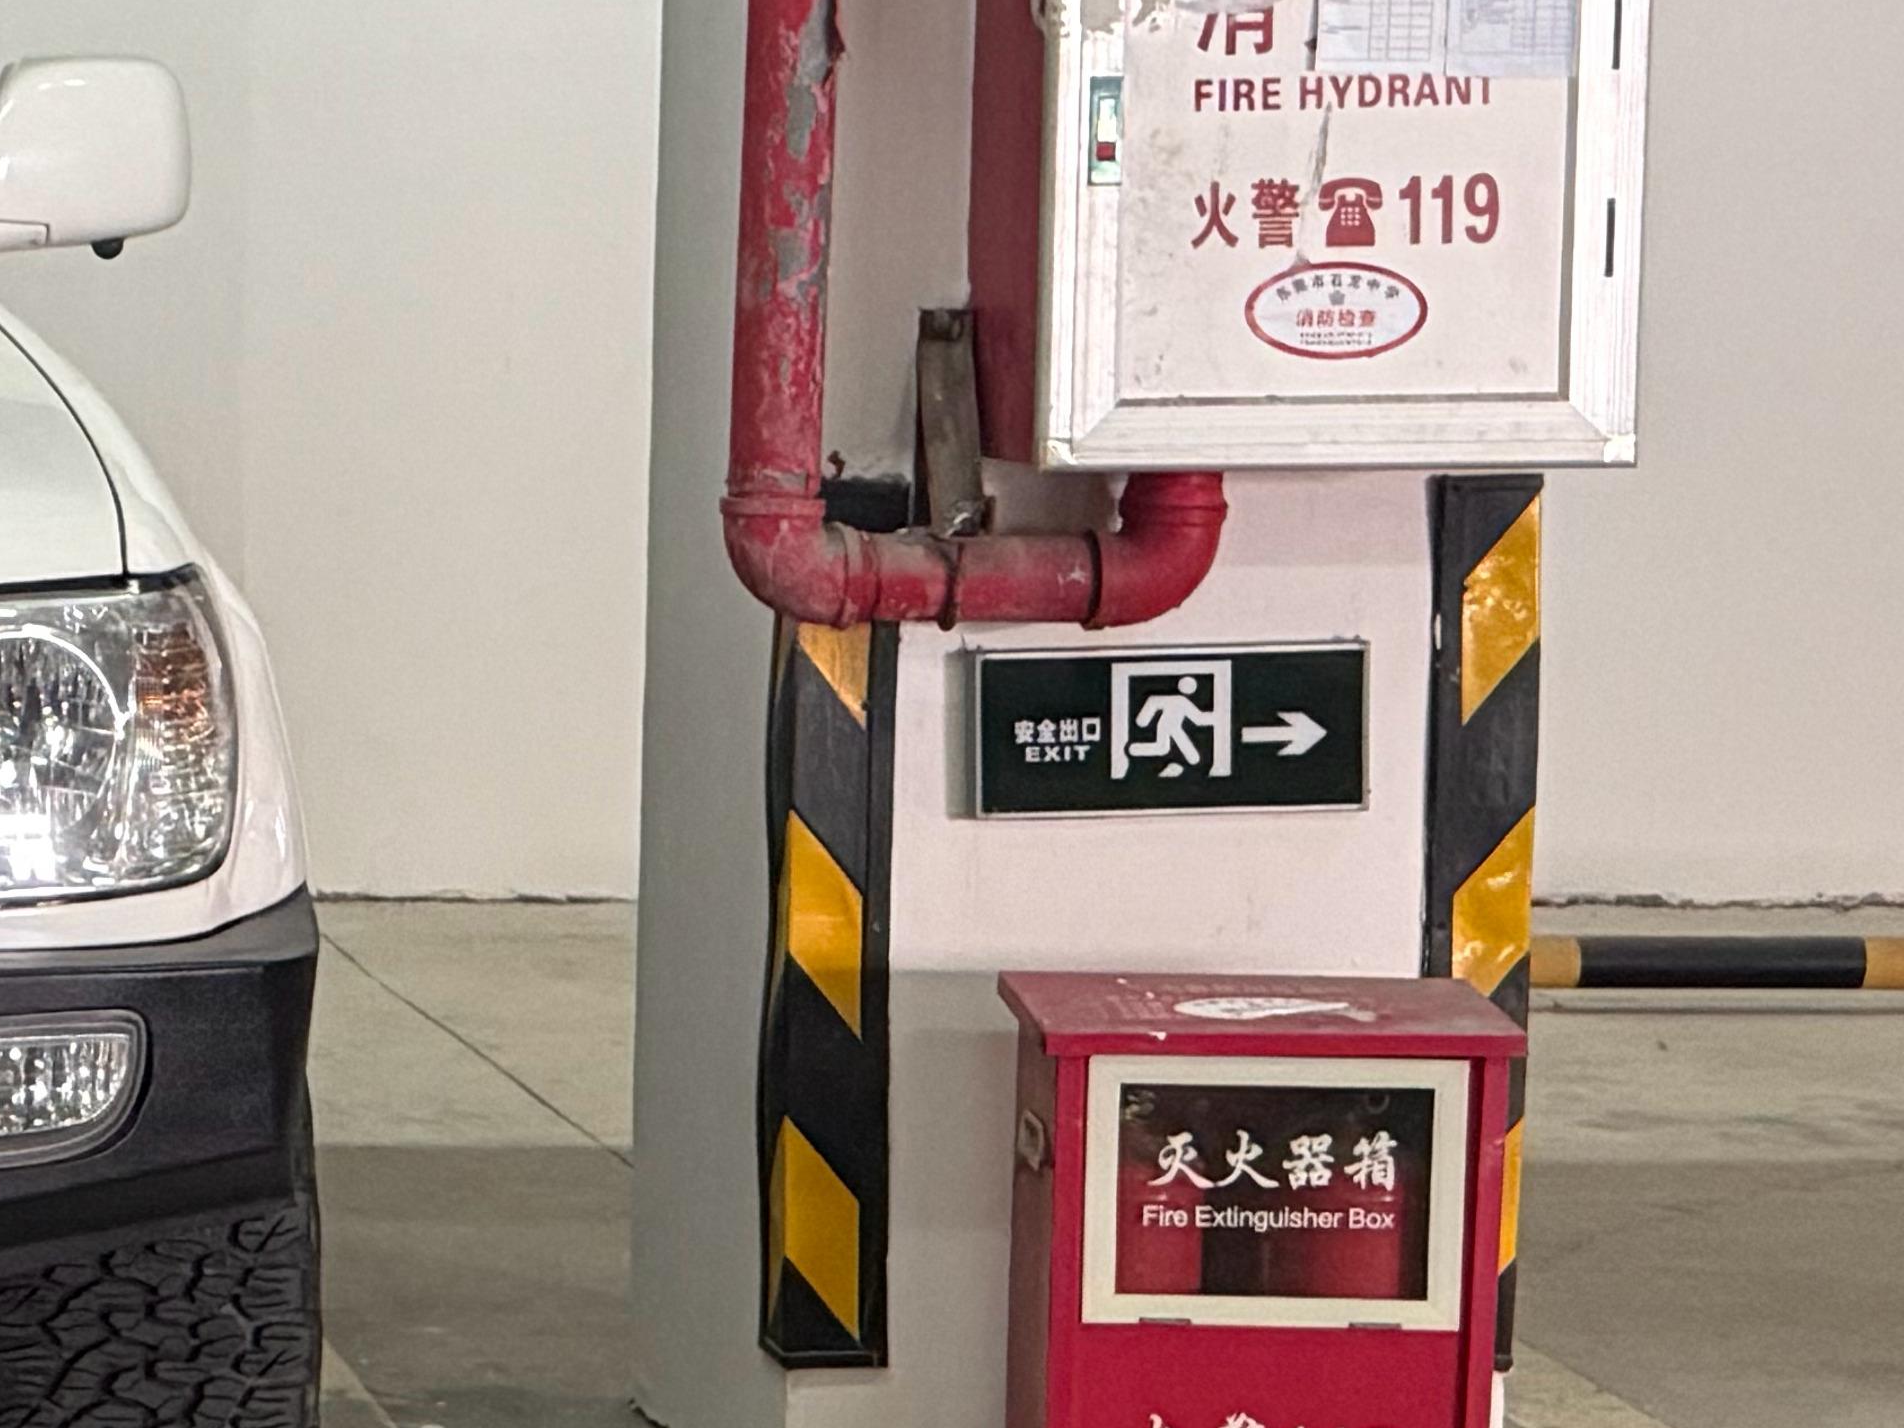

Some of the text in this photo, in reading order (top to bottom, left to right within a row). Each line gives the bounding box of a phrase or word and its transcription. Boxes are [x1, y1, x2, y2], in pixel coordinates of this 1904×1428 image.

[1194, 78, 1282, 111] FIRE
[1191, 172, 1499, 248] 火警 119
[1013, 717, 1101, 744] 安全出口
[1025, 746, 1090, 762] EXIT
[1146, 1129, 1398, 1192] 灭火器箱
[1141, 1205, 1395, 1233] Fire Extinguisher Box
